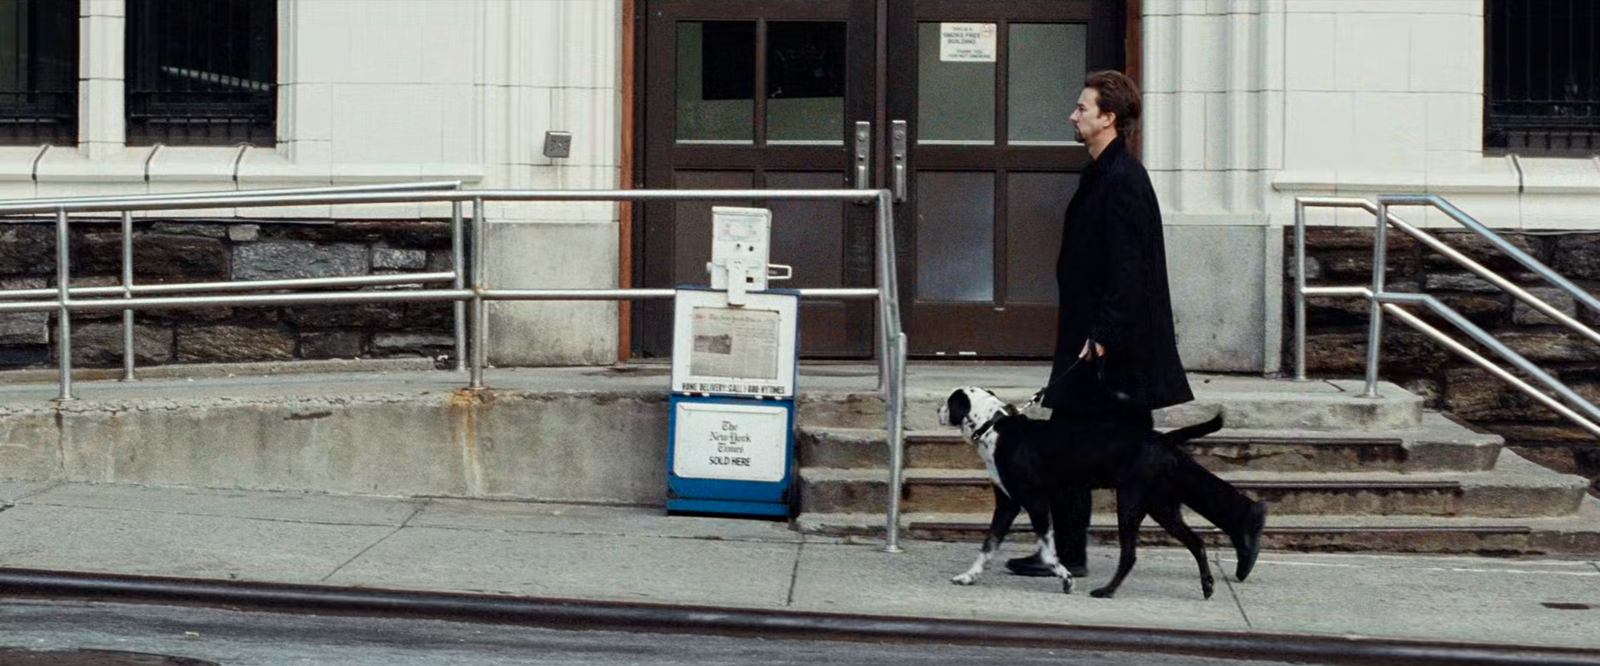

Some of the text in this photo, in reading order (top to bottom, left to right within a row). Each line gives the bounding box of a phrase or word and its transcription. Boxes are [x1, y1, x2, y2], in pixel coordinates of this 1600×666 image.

[682, 382, 699, 391] HOME
[722, 420, 738, 432] The
[709, 431, 752, 445] New York
[717, 442, 745, 454] Times
[709, 456, 751, 467] SOLD HERE
